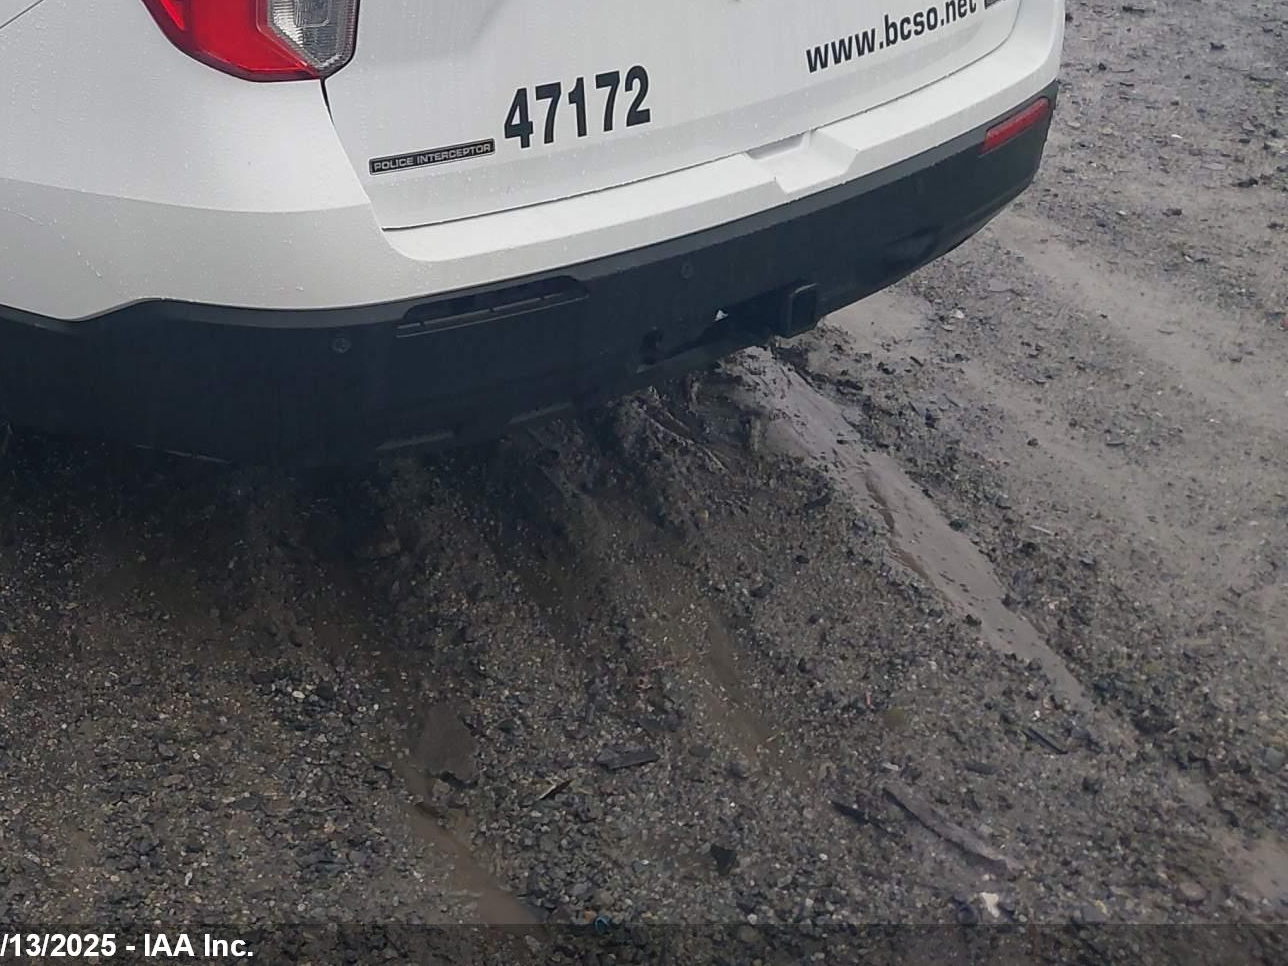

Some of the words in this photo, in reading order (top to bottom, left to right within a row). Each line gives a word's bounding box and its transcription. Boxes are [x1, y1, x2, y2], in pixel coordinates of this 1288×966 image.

[504, 65, 651, 149] 47172
[373, 157, 414, 171] POLICE
[416, 143, 491, 164] INTERCEPTOR
